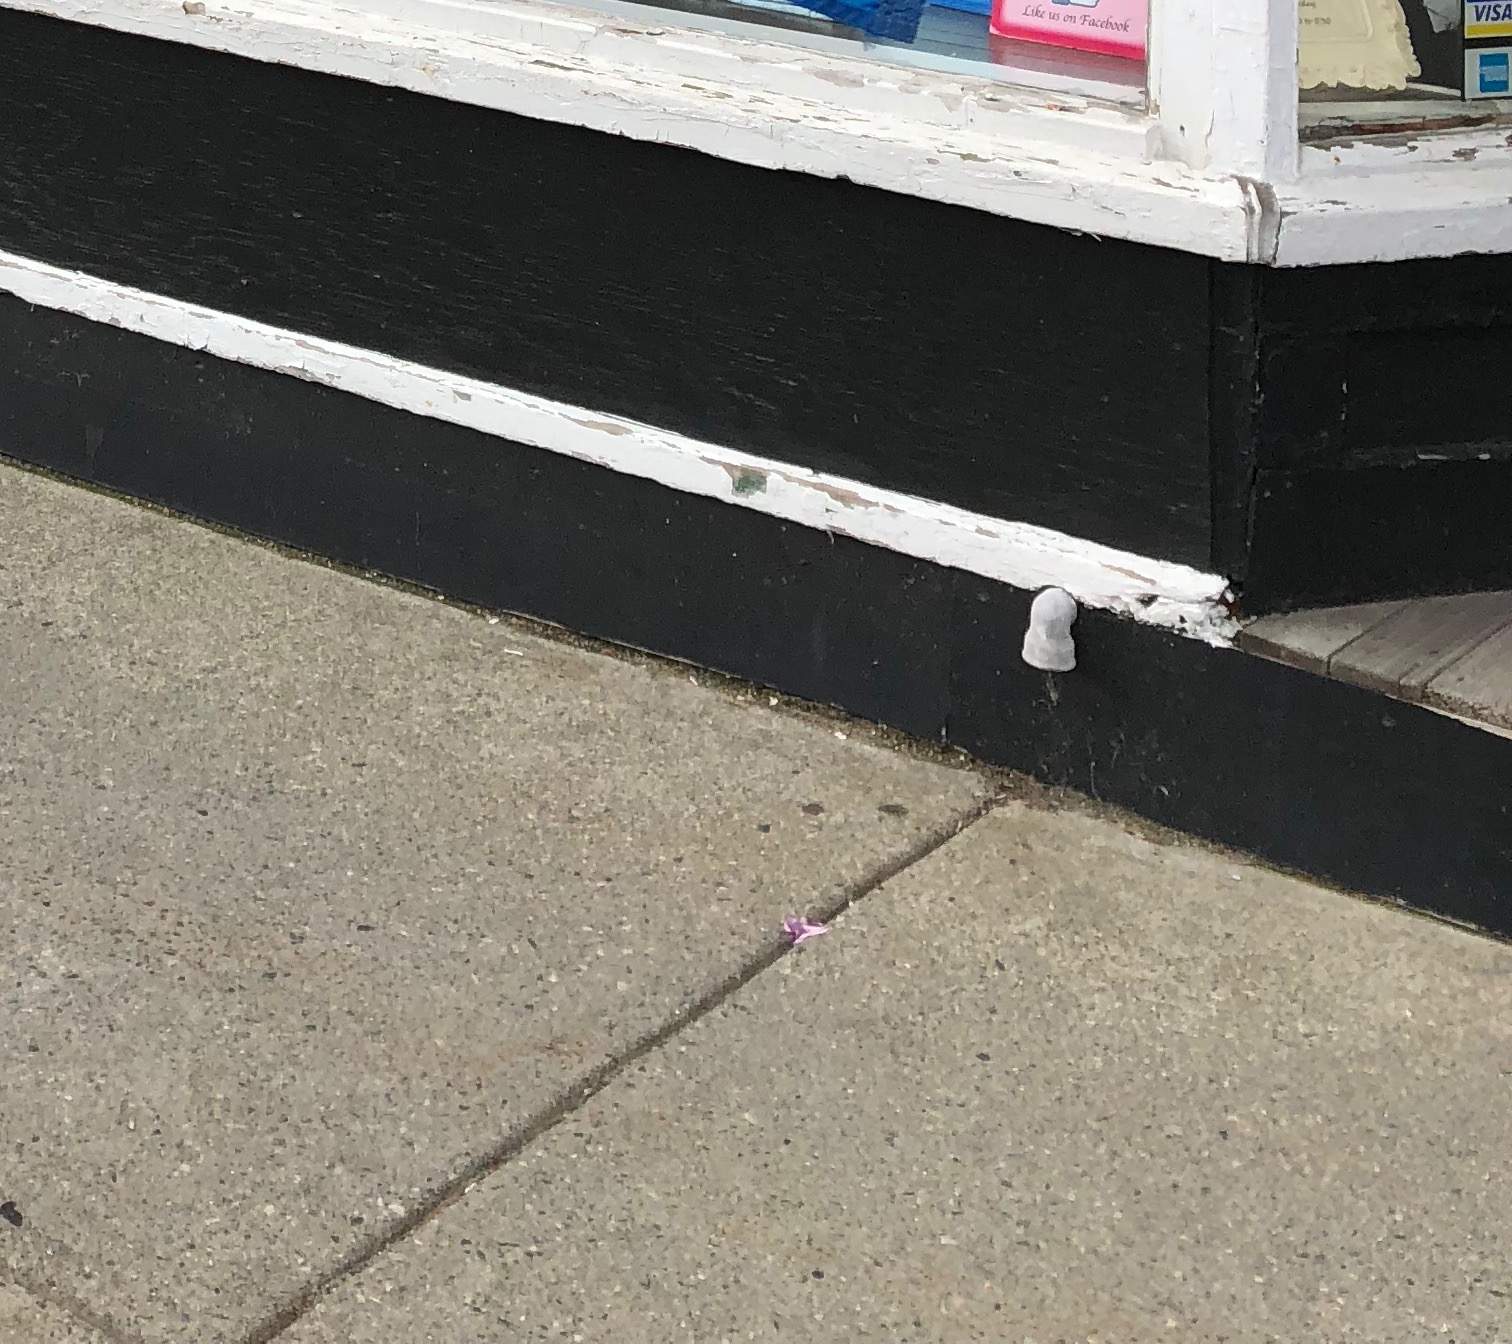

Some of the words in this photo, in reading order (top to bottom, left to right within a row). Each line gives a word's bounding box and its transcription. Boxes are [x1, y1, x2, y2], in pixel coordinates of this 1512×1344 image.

[1021, 4, 1046, 19] Like
[1048, 10, 1061, 22] us
[1063, 13, 1077, 24] on
[1080, 12, 1130, 33] Facebook
